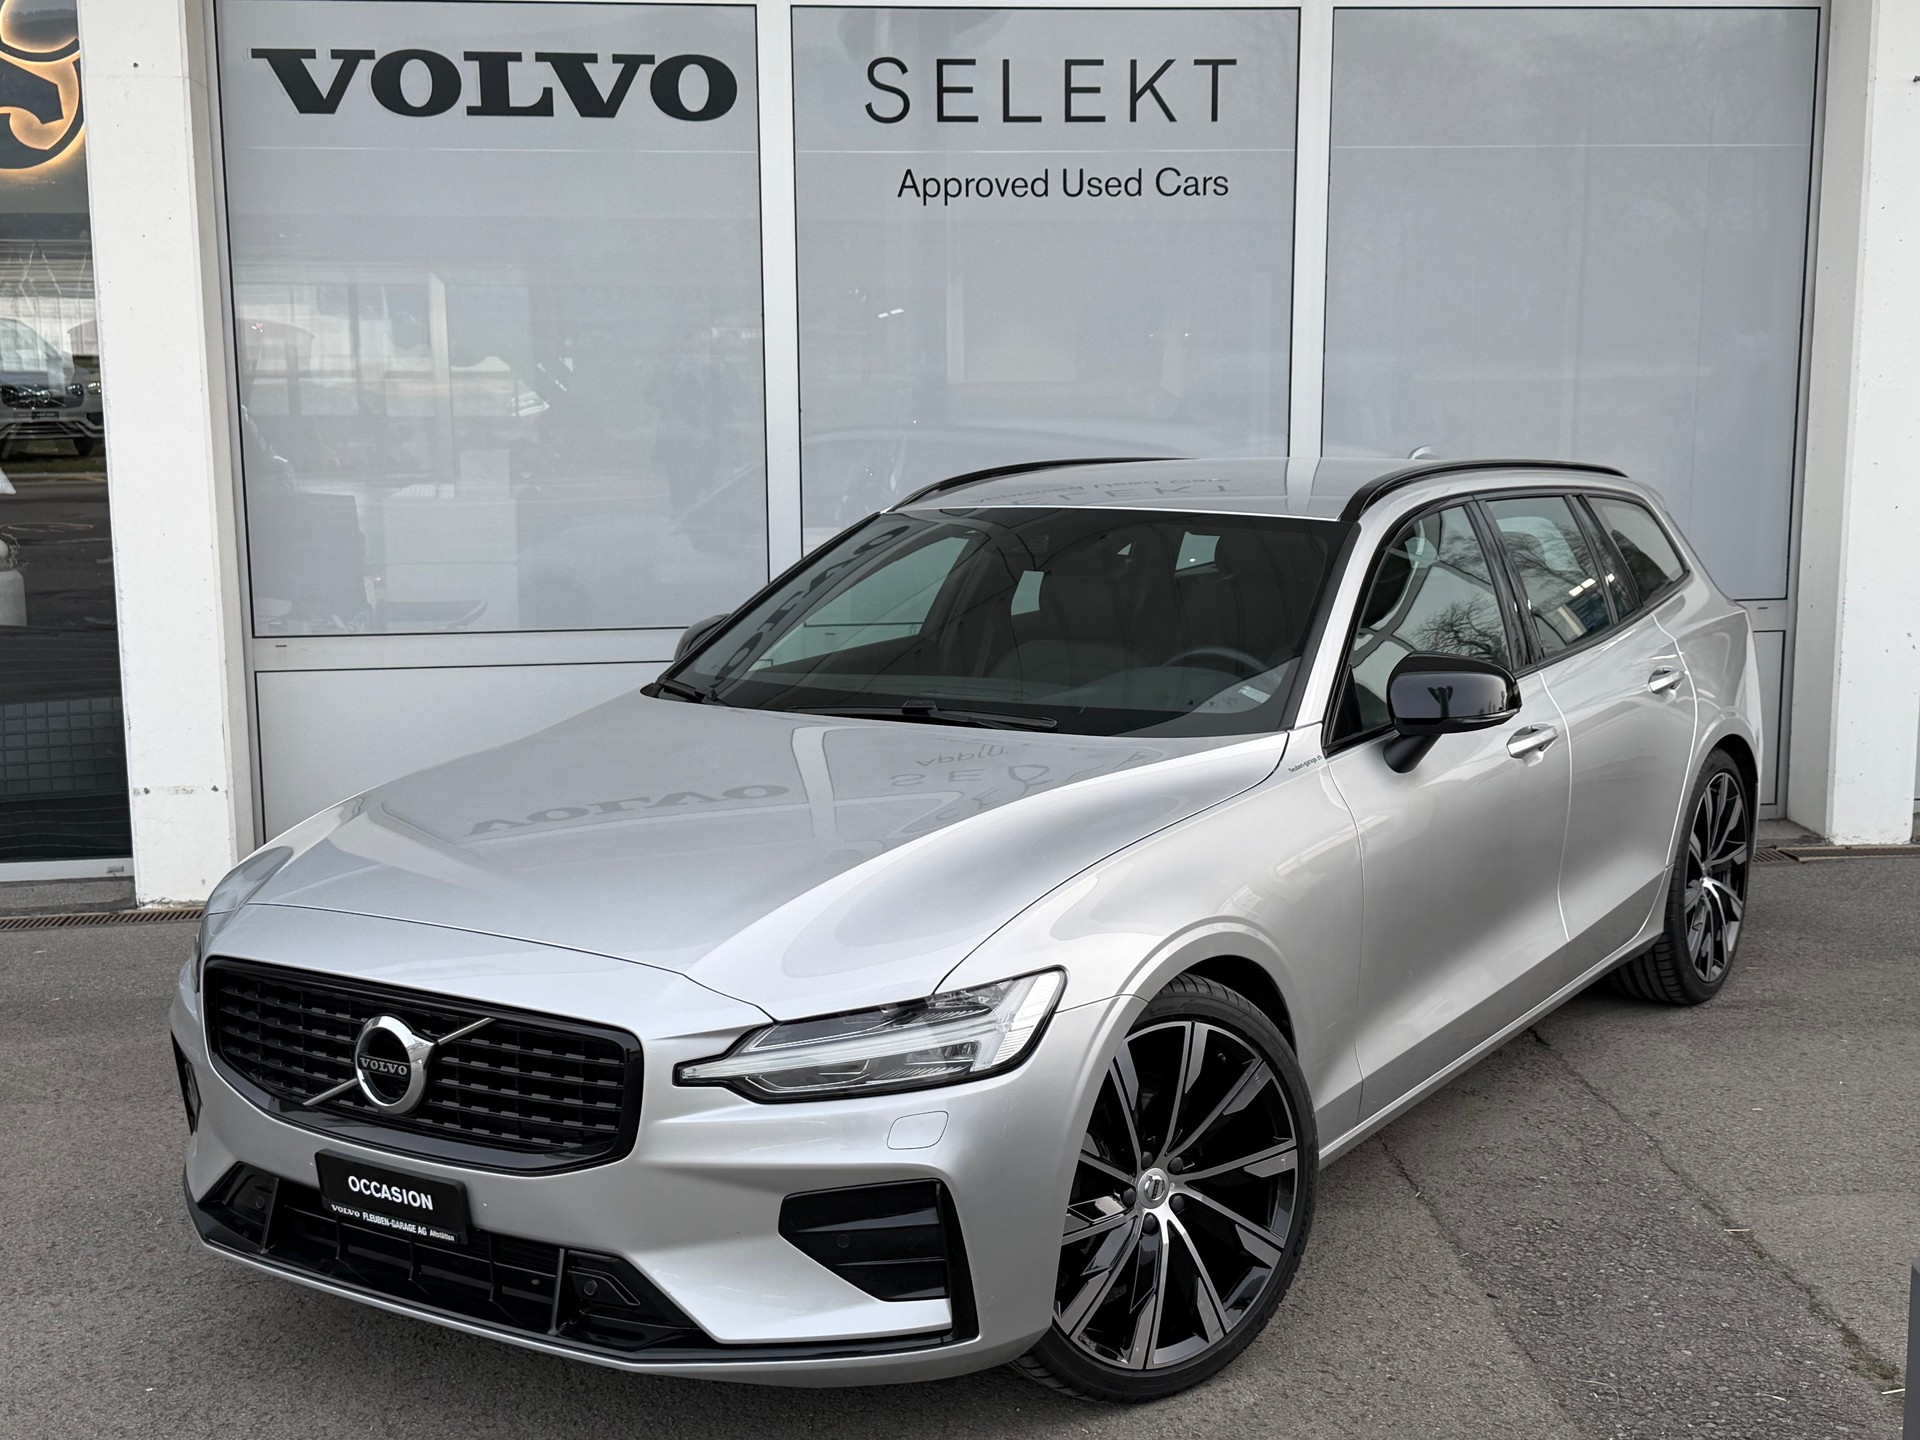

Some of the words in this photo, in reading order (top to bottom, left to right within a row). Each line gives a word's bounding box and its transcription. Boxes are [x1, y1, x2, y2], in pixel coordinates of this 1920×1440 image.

[251, 48, 737, 121] VOLVO
[865, 57, 1237, 124] SELEKT
[897, 168, 1048, 206] Approved
[1063, 168, 1142, 198] Used
[1155, 167, 1229, 197] Cars
[359, 1057, 408, 1075] VOLVO
[347, 1175, 434, 1211] OCCASION
[331, 1203, 361, 1218] VOLVO
[362, 1211, 417, 1234] FLEUBEN-GARAGE
[417, 1225, 428, 1237] AG
